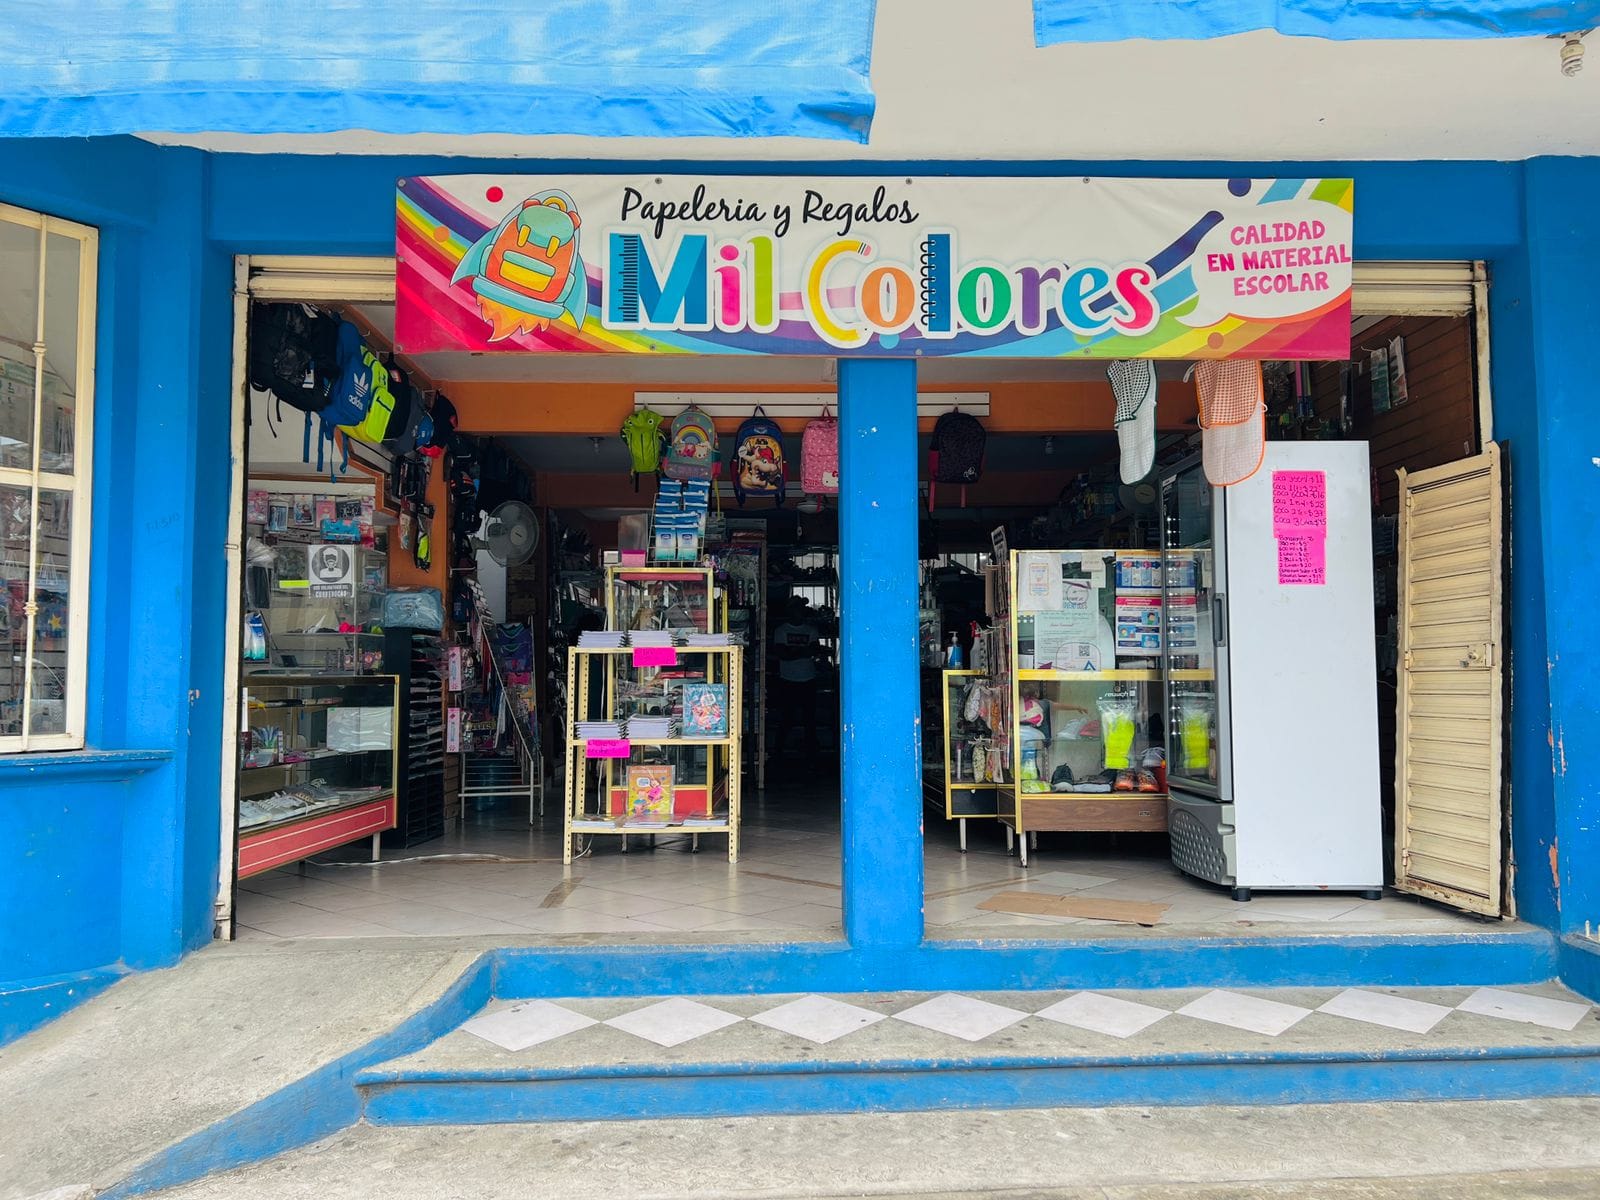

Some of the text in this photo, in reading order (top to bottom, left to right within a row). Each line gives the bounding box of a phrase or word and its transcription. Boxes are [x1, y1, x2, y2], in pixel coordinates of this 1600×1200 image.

[621, 186, 919, 239] Papeleria y Regalos
[1230, 220, 1326, 246] CALIDAD
[1207, 244, 1351, 273] EN MATERIAL
[608, 233, 1151, 341] Mil Colores
[1233, 271, 1329, 297] ESCOLAR
